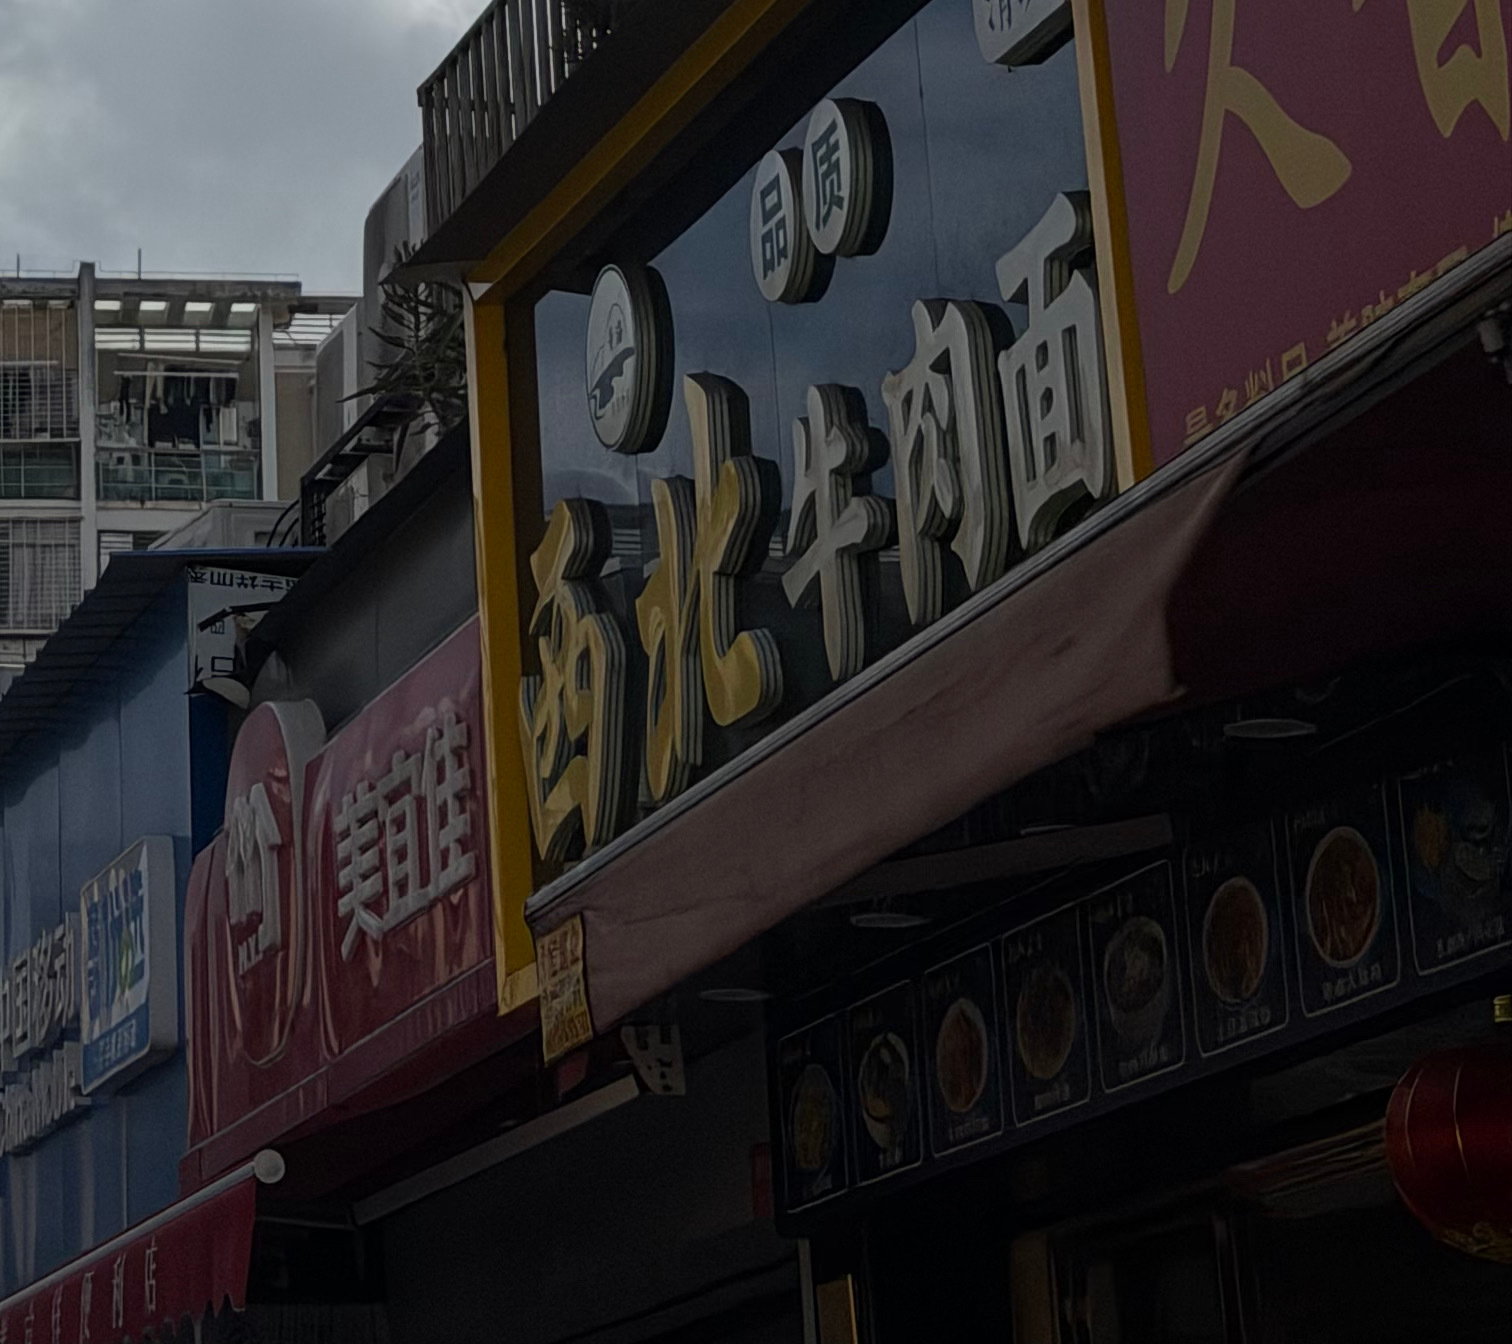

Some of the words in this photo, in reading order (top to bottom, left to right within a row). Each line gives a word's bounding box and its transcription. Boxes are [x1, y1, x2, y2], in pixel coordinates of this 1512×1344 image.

[760, 118, 846, 278] 品质
[336, 712, 477, 962] 美宜佳
